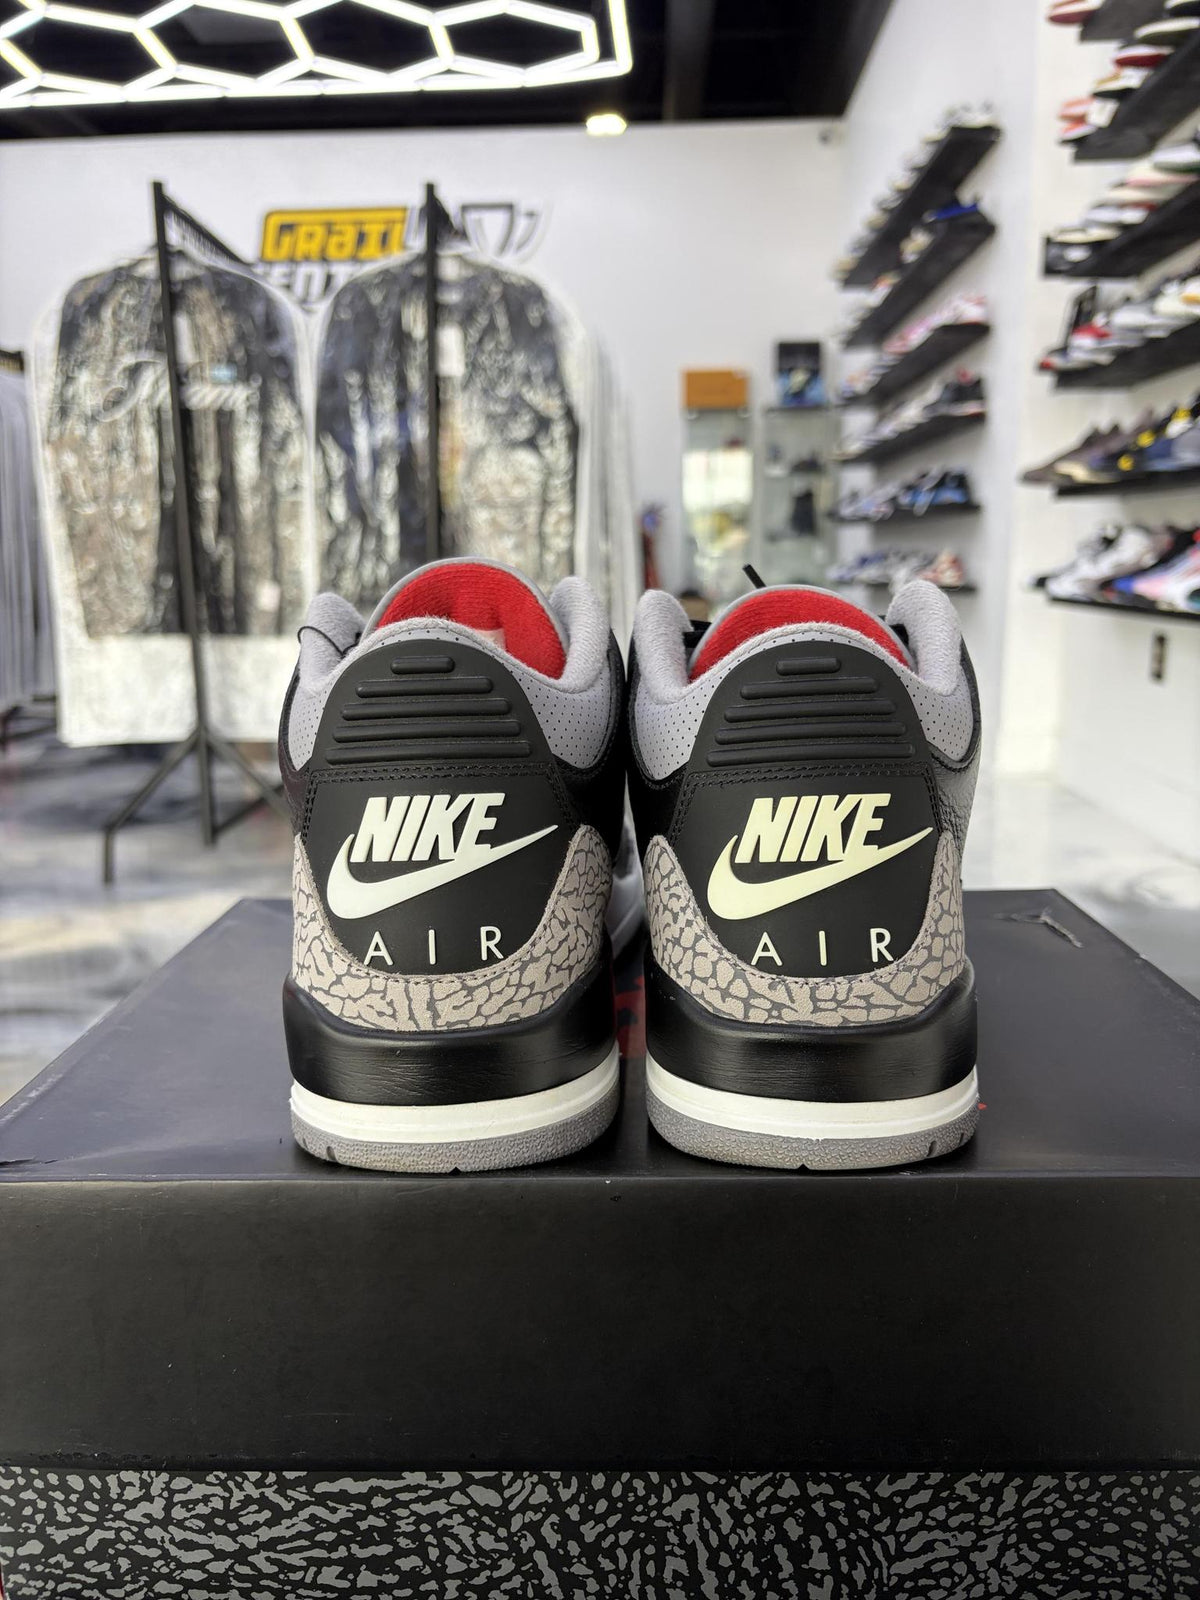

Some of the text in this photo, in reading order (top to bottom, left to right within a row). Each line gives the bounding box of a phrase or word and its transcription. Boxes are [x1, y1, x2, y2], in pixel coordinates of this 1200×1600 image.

[350, 792, 505, 862] NIKE
[734, 793, 891, 863] NIKE
[363, 926, 504, 965] AIR
[751, 927, 894, 966] AIR
